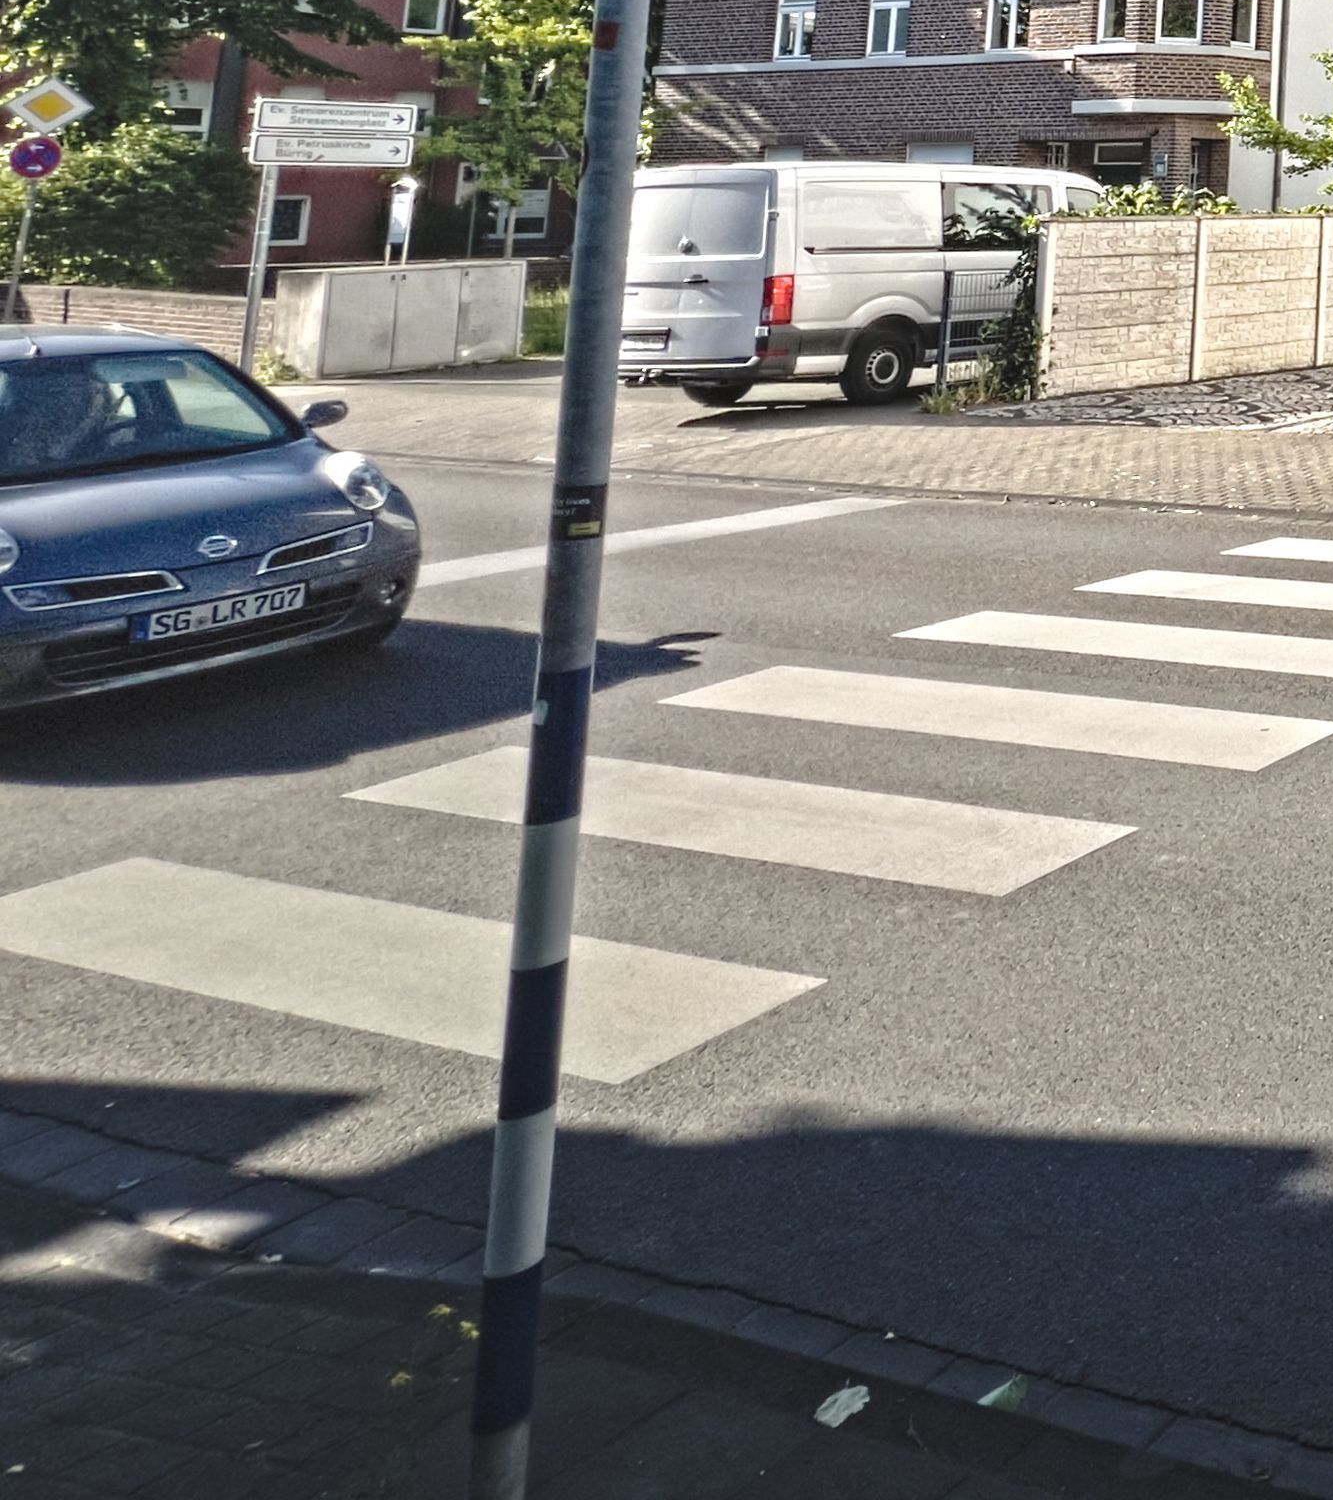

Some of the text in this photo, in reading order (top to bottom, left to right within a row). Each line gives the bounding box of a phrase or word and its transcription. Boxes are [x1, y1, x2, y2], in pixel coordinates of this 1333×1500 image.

[152, 587, 301, 636] SG LR 707
